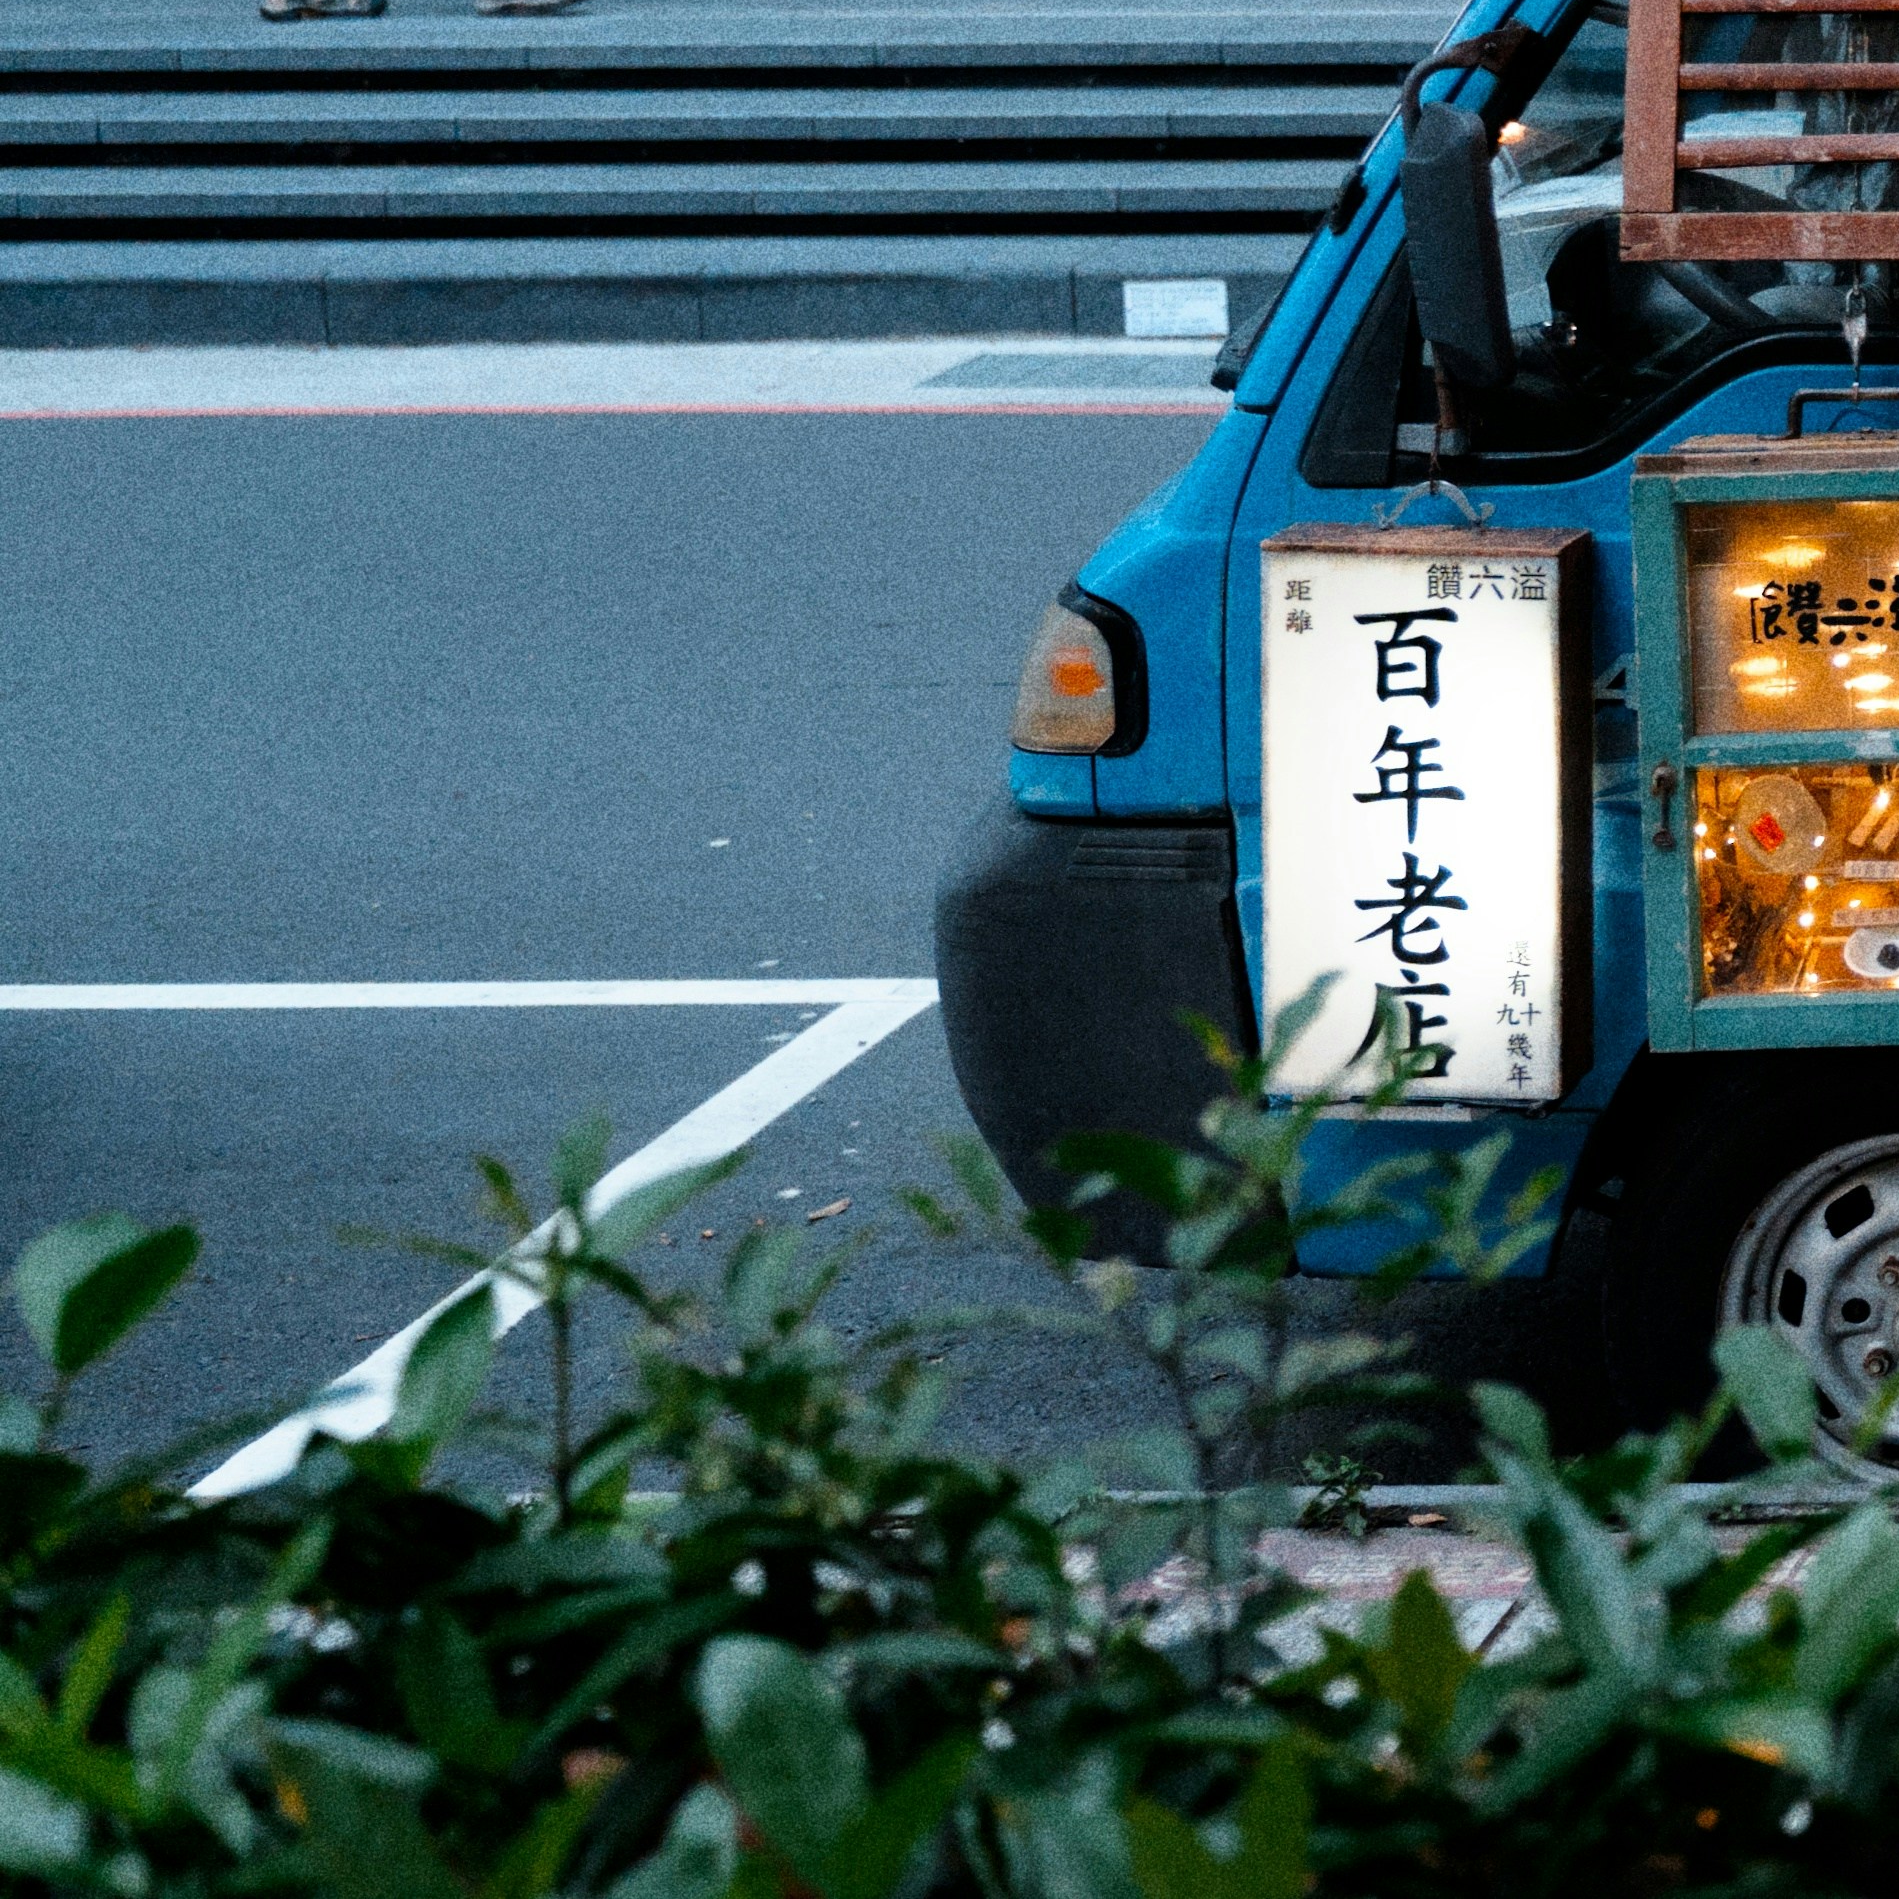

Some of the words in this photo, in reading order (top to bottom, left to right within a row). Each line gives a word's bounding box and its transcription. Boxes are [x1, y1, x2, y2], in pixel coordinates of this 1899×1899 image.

[1284, 579, 1313, 635] 距離
[1344, 606, 1469, 1080] 百年老店
